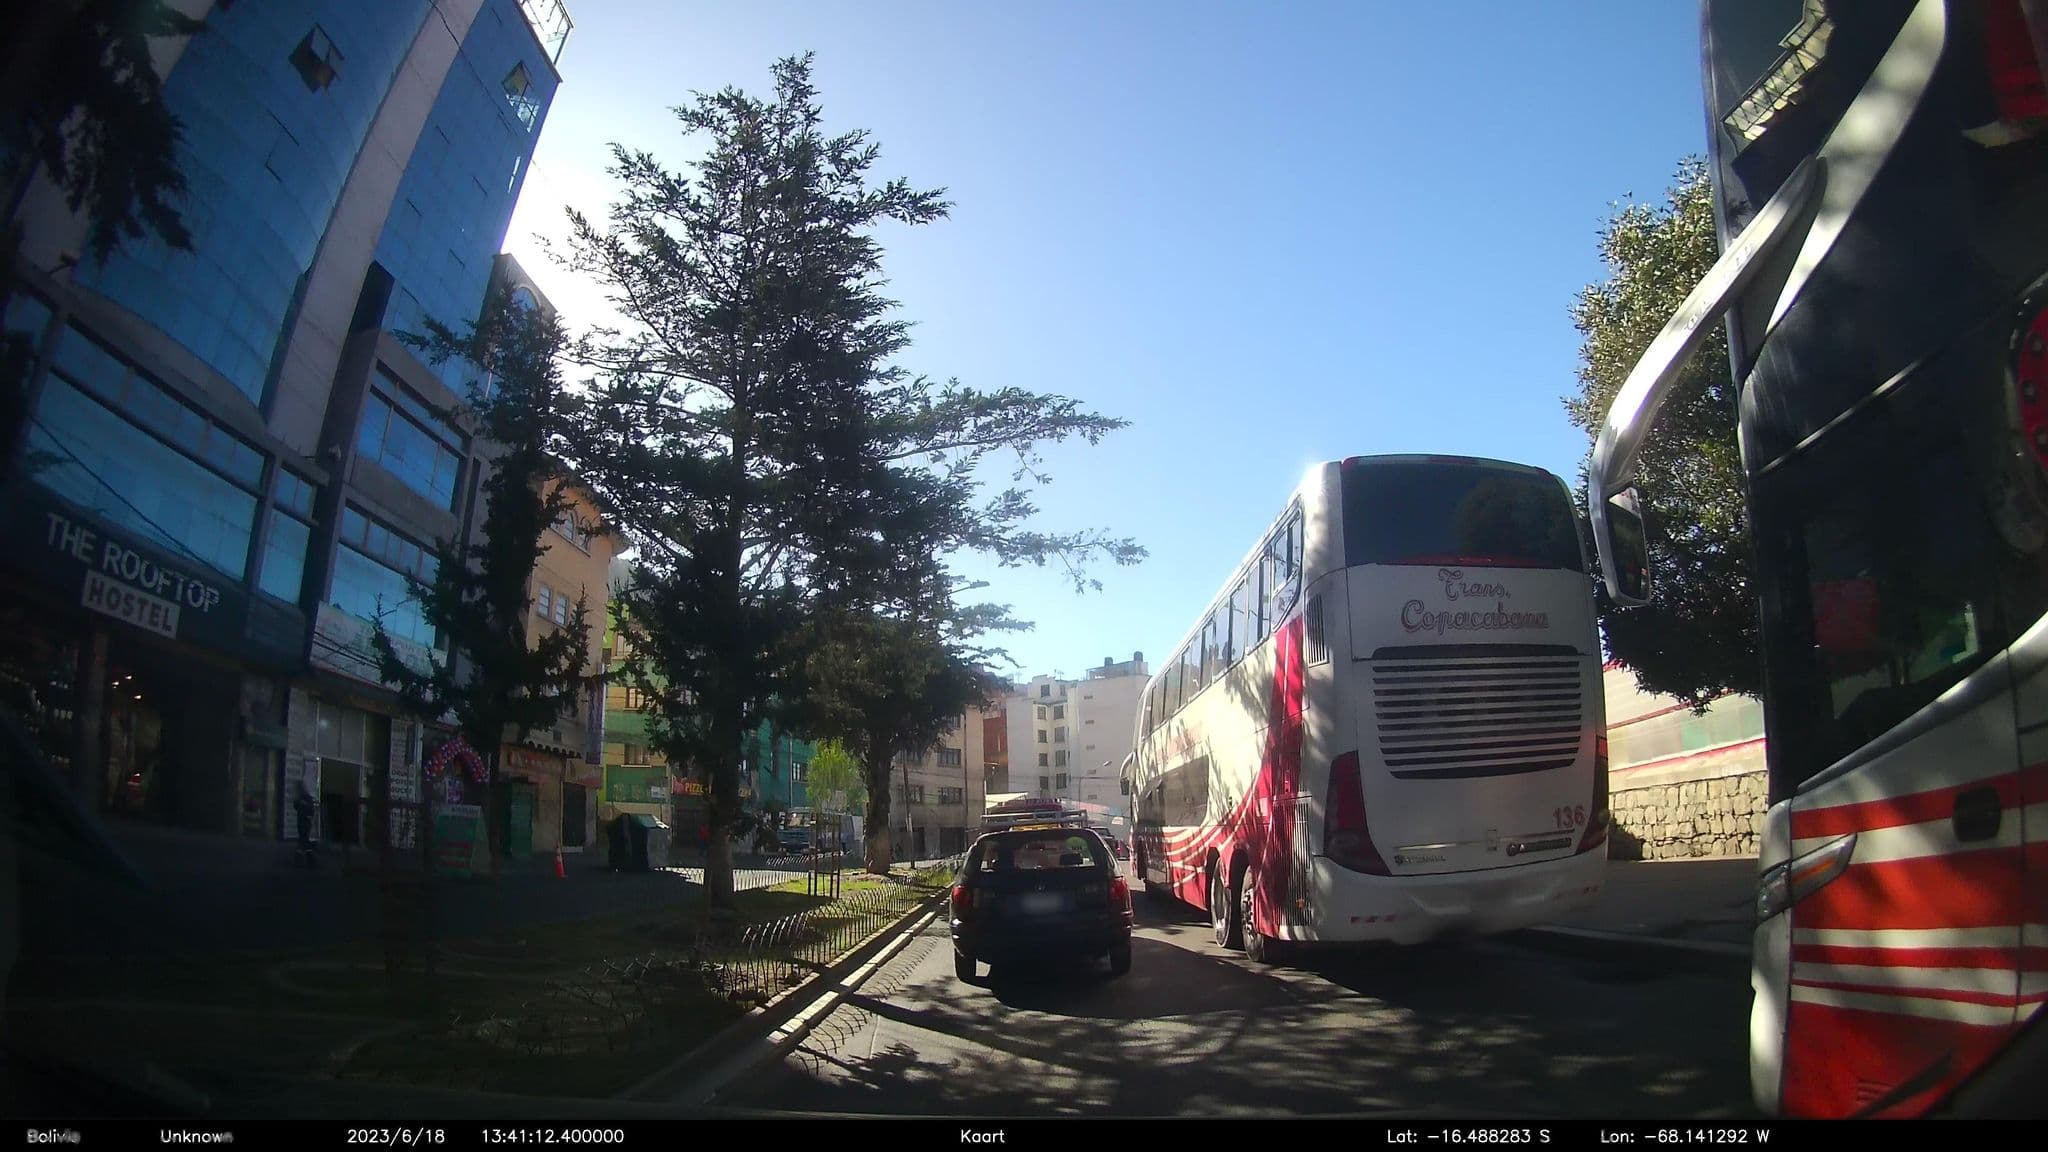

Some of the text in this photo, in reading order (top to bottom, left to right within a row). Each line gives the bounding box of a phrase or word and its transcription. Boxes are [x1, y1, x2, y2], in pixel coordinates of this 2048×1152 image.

[47, 512, 220, 613] THE ROOFTOP
[87, 577, 172, 632] HOSTEL
[1401, 599, 1549, 635] Copacabana
[1552, 806, 1586, 828] 136
